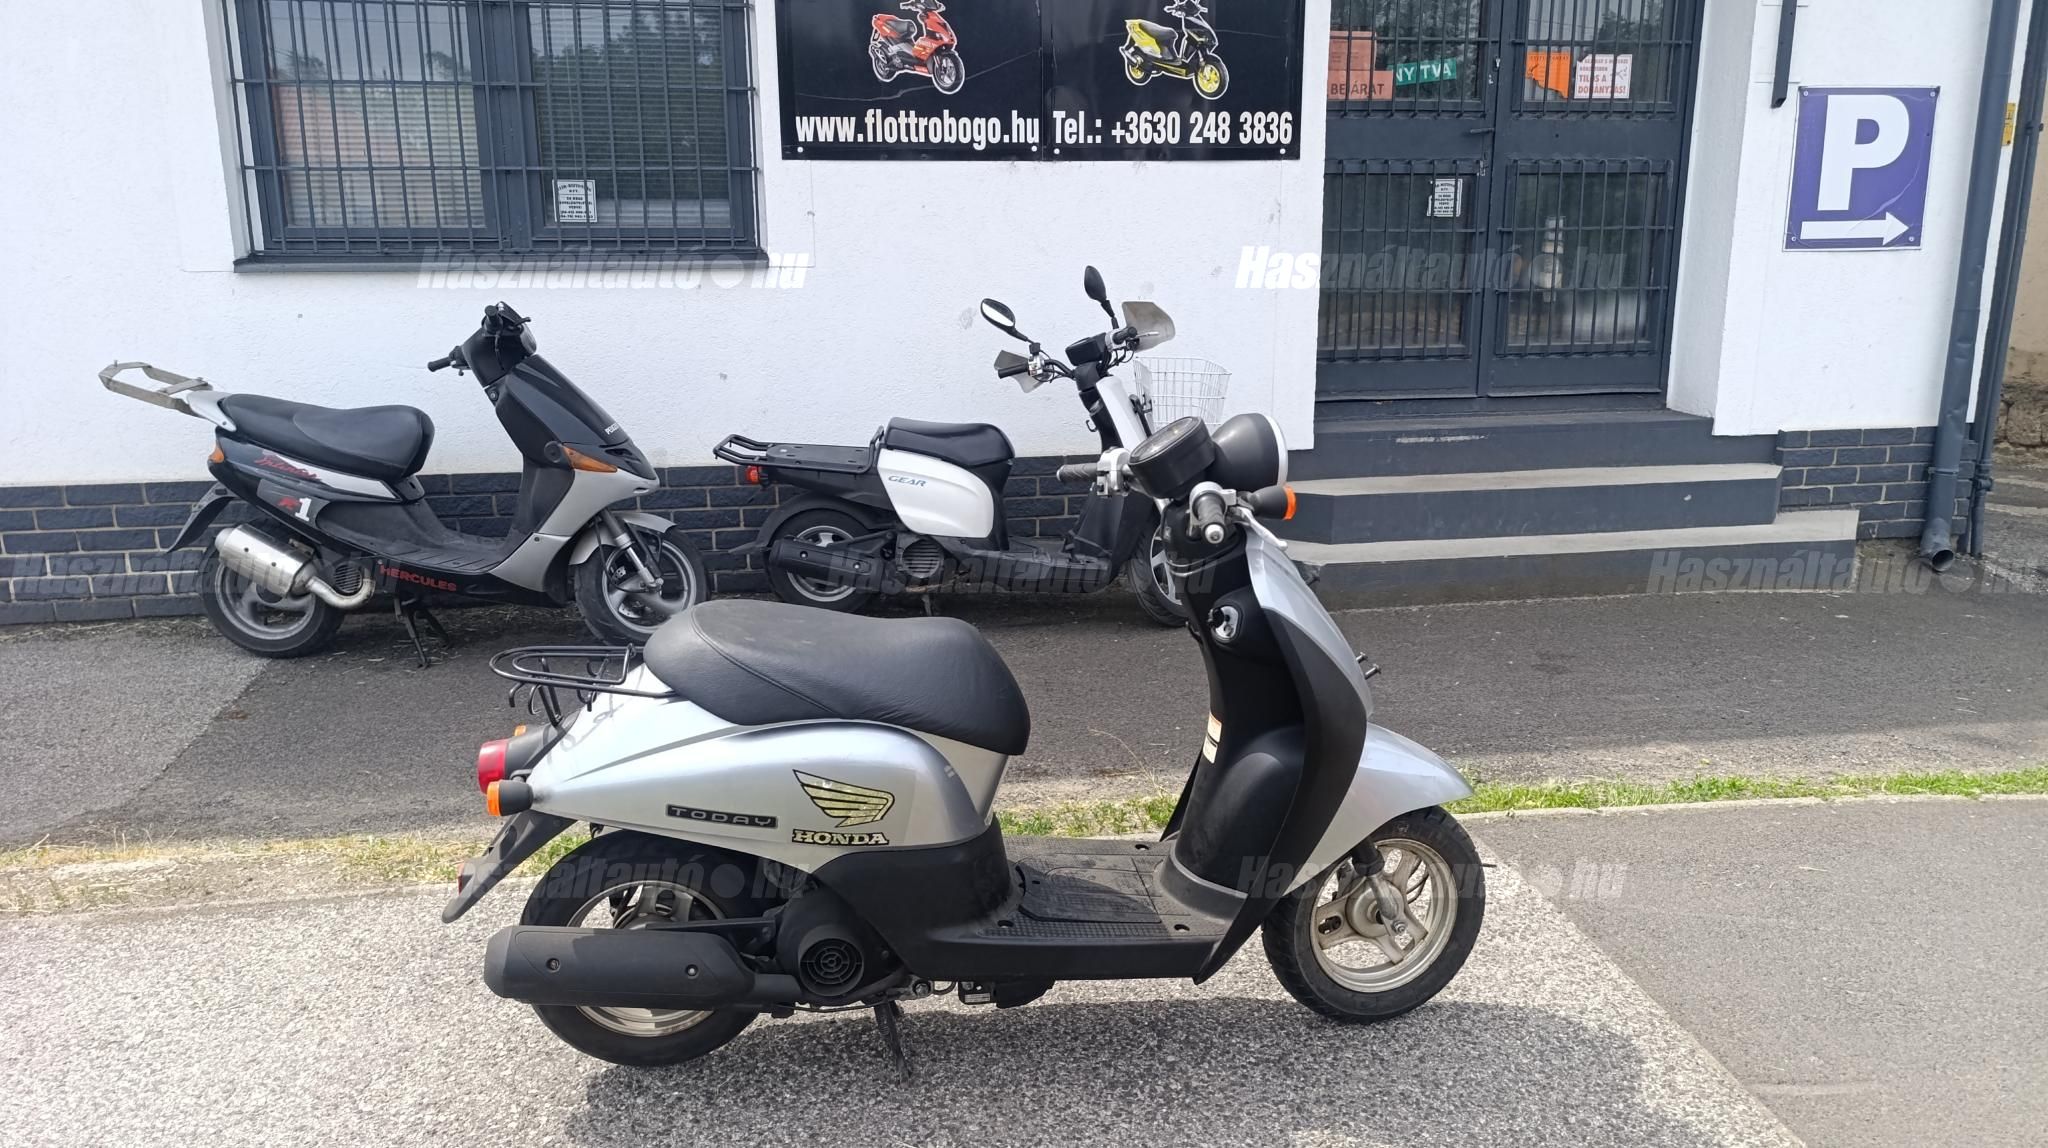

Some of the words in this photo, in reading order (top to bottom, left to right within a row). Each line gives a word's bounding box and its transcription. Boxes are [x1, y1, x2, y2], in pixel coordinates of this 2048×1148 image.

[1330, 80, 1385, 95] BEÁRAT
[1579, 74, 1601, 82] TILS
[796, 109, 1040, 150] www.flottrobogo.hu
[1053, 110, 1102, 144] Tel.:
[1111, 111, 1181, 144] +3630
[1189, 111, 1231, 144] 248
[1239, 111, 1293, 144] 3836
[1817, 94, 1910, 211] P
[888, 475, 927, 487] GEAR
[379, 563, 457, 592] HERCULES
[671, 807, 772, 826] TODAY
[793, 829, 889, 845] HONDA
